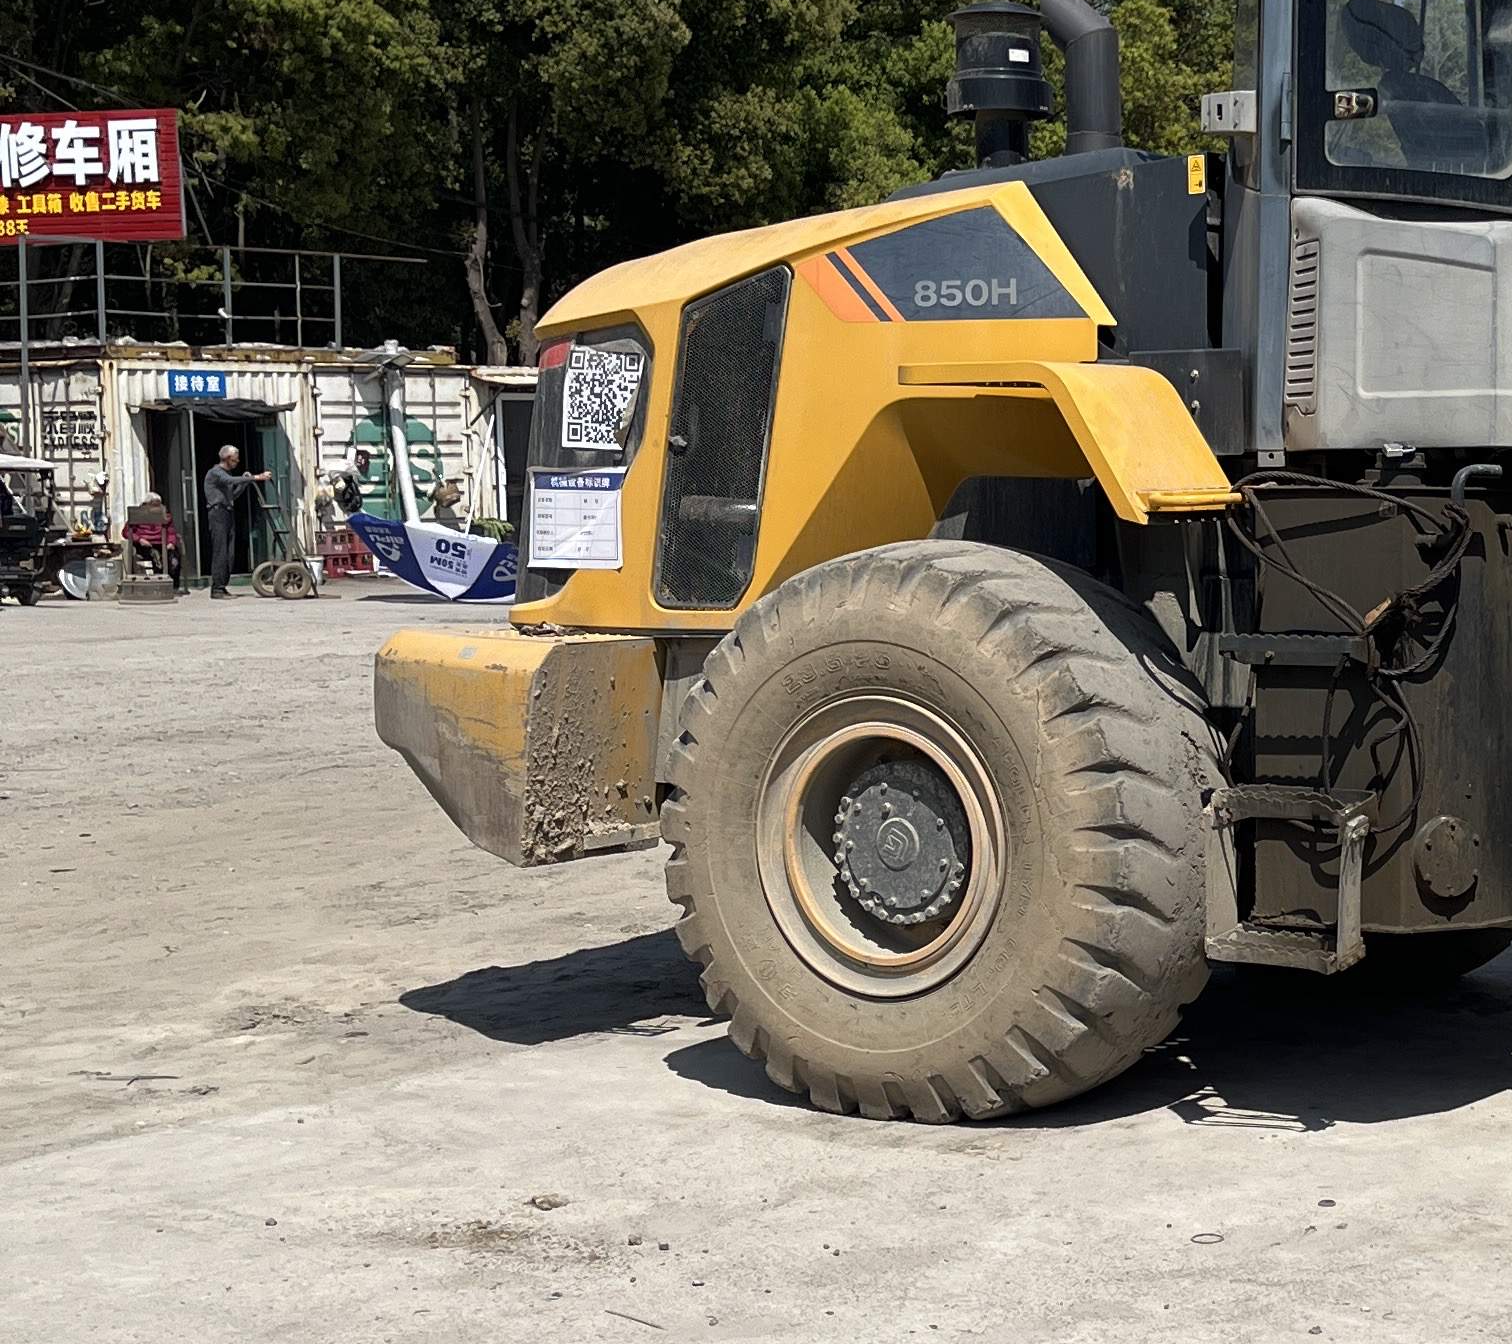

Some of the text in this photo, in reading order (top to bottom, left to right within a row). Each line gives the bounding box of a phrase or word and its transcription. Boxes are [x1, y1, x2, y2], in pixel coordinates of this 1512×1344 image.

[0, 118, 159, 188] 修车厢
[913, 277, 1018, 307] 850H
[174, 374, 221, 393] 接待室
[435, 538, 467, 560] 50
